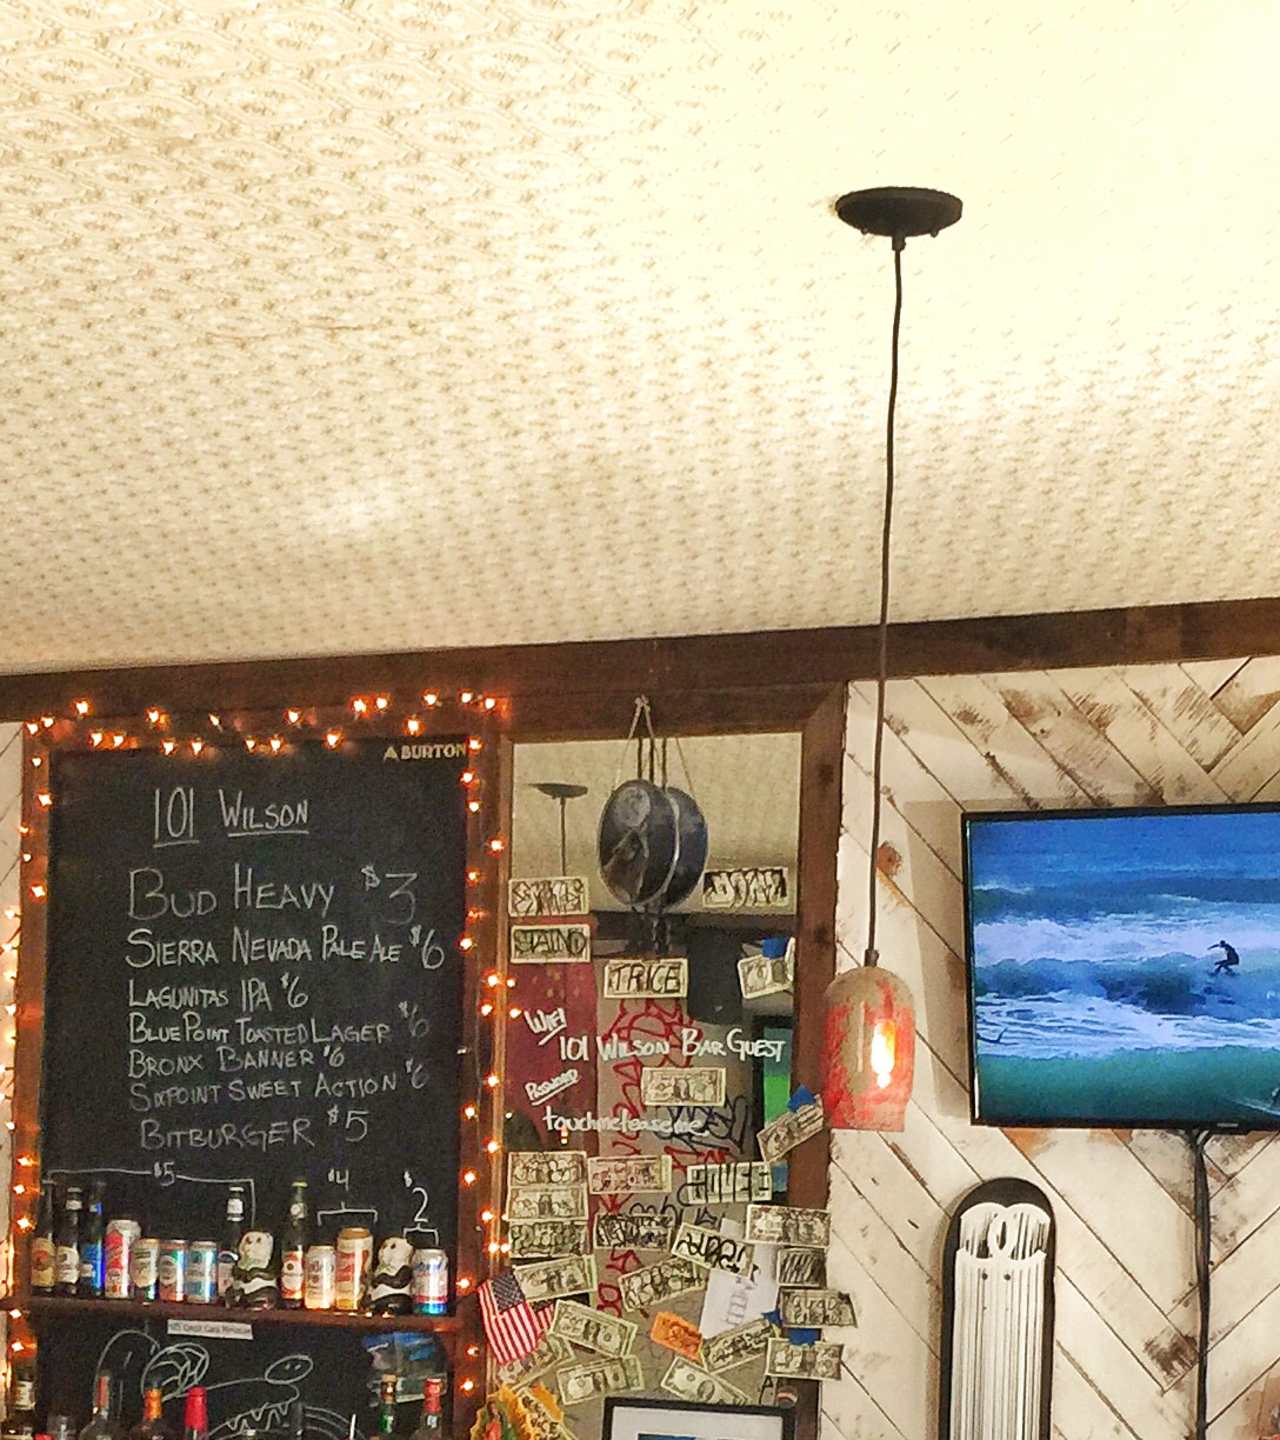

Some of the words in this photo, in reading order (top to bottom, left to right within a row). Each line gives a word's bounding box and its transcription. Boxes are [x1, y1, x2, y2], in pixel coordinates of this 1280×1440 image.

[401, 743, 467, 760] BURTON
[154, 788, 197, 838] 101
[219, 789, 309, 831] WILSON
[128, 867, 217, 921] BUD
[234, 863, 335, 918] HEAVY
[360, 864, 418, 924] $3
[125, 928, 219, 969] SIERRA
[232, 926, 313, 965] NEVADA
[321, 925, 366, 961] PALE
[368, 939, 403, 964] ALE
[409, 924, 445, 970] $6
[128, 978, 229, 1009] LAGUNITAS
[240, 978, 272, 1012] IPA
[281, 972, 309, 1009] $6
[608, 961, 683, 996] TRICE
[235, 1018, 308, 1046] TOASTED
[311, 1016, 391, 1044] LAGER
[560, 1036, 589, 1062] 101
[596, 1033, 671, 1062] WILSON
[682, 1027, 727, 1058] BAR
[726, 1026, 787, 1062] GUEST
[128, 1049, 203, 1079] BRONX
[216, 1045, 315, 1073] BANNER
[228, 1081, 302, 1102] SWEET
[314, 1072, 398, 1100] ACTION
[140, 1117, 316, 1152] BITBURGER
[327, 1104, 369, 1143] $5
